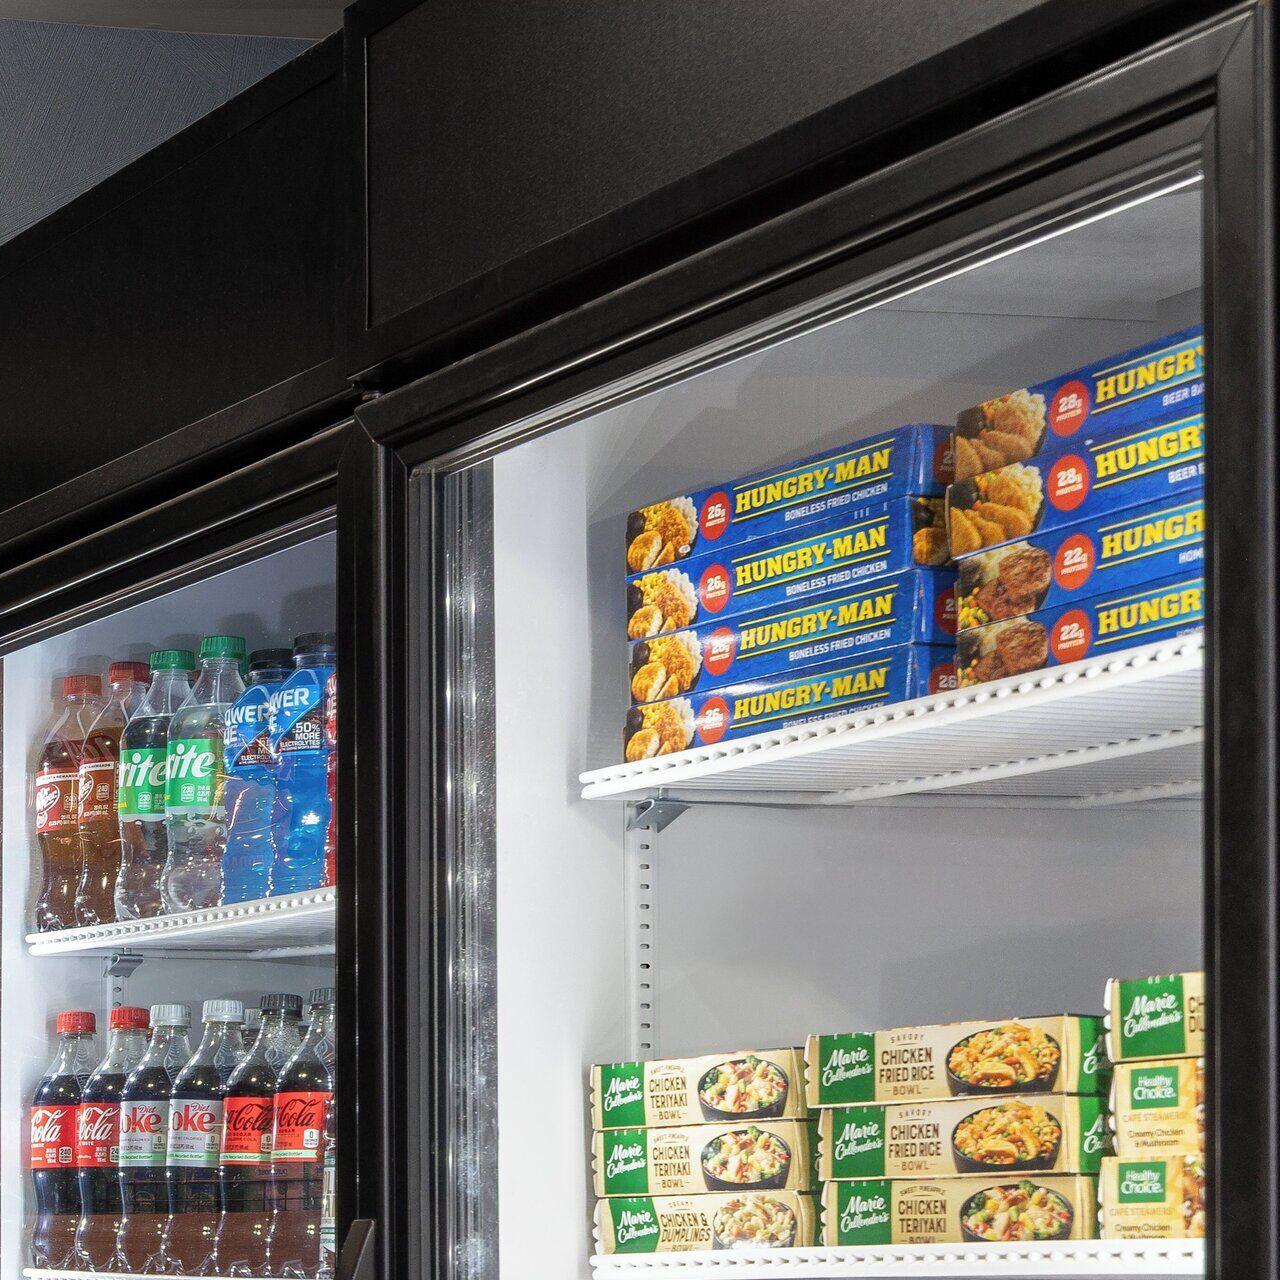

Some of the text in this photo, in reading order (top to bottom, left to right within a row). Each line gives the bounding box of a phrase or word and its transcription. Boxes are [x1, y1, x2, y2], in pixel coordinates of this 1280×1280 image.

[735, 448, 891, 514] HUNGRY-MAN
[1168, 466, 1196, 483] BEER
[785, 482, 888, 521] BONELESS FRIED CHICKEN
[736, 525, 887, 586] HUNGRY-MAN
[785, 560, 887, 596] BONELESS FRIED CHICKEN
[740, 594, 893, 650] HUNGRY-MAN
[789, 629, 891, 661] BONELESS FRIED CHICKEN
[733, 668, 888, 719] HUNGRY-MAN
[295, 732, 320, 740] MORE
[1124, 993, 1178, 1020] Marie
[826, 1047, 869, 1071] Marie
[881, 1048, 933, 1065] CHICKEN
[880, 1067, 935, 1084] FRIED RICE
[1138, 1076, 1172, 1088] Healthy
[608, 1077, 640, 1097] Marie
[649, 1078, 687, 1093] CHICKEN
[893, 1084, 921, 1095] BOWL
[1133, 1086, 1173, 1100] Choice
[650, 1093, 688, 1108] TERIYAKI
[658, 1110, 682, 1121] BOWL
[890, 1123, 940, 1140] CHICKEN
[652, 1146, 690, 1160] CHICKEN
[889, 1142, 942, 1158] FRIED RICE
[654, 1161, 690, 1177] TERIYAKI
[1126, 1170, 1160, 1182] Healthy
[1121, 1180, 1161, 1194] Choice
[898, 1200, 947, 1216] CHICKEN
[620, 1211, 653, 1229] Marie
[660, 1213, 708, 1228] CHICKEN &
[899, 1218, 947, 1233] TERIYAKI
[662, 1228, 711, 1241] DUMPLINGS
